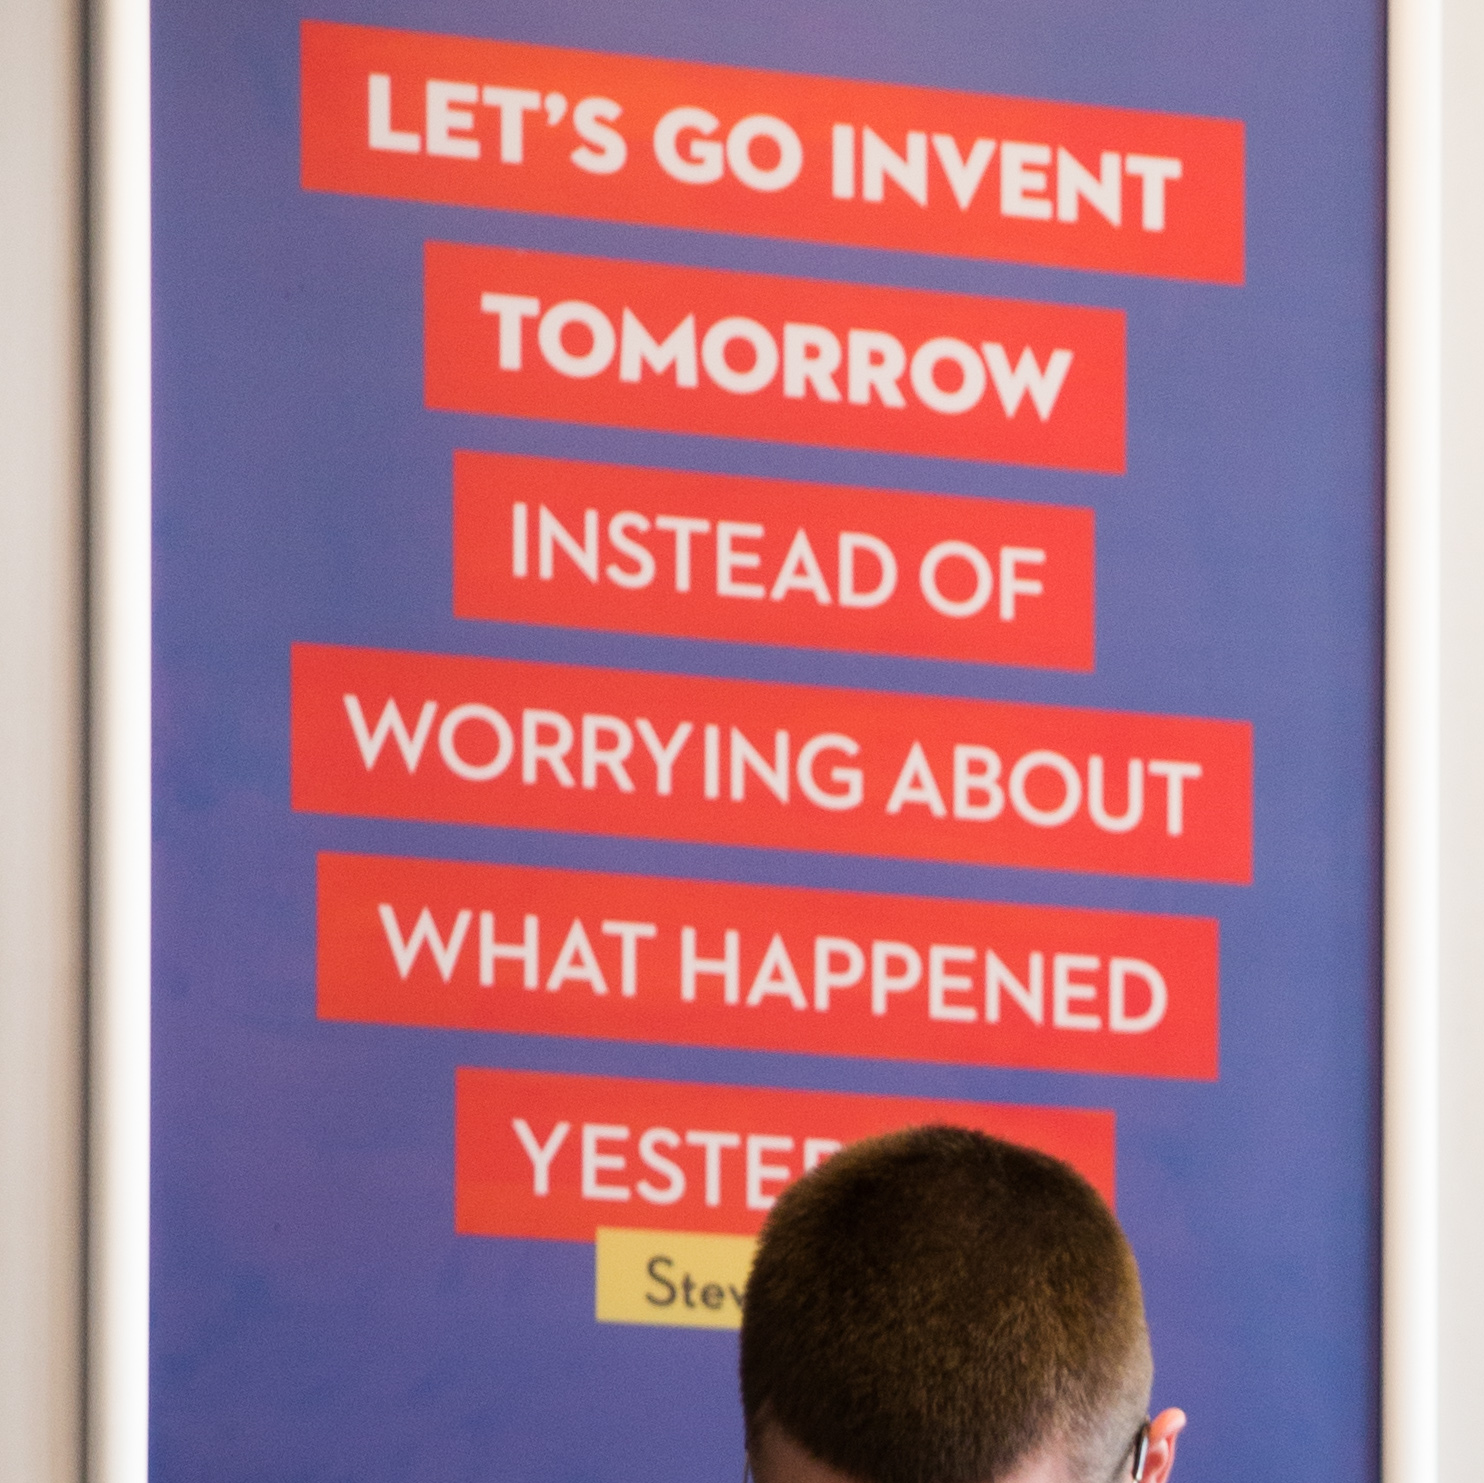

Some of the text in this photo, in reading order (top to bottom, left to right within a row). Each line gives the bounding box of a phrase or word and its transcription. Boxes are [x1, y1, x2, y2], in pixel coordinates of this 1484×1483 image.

[651, 105, 805, 194] GO
[830, 122, 1185, 234] INVENT
[479, 291, 1075, 422] TOMORROW
[511, 501, 1048, 623] INSTEAD OF
[342, 693, 1204, 838] WORRYING ABOUT
[377, 902, 1170, 1035] WHAT HAPPENED
